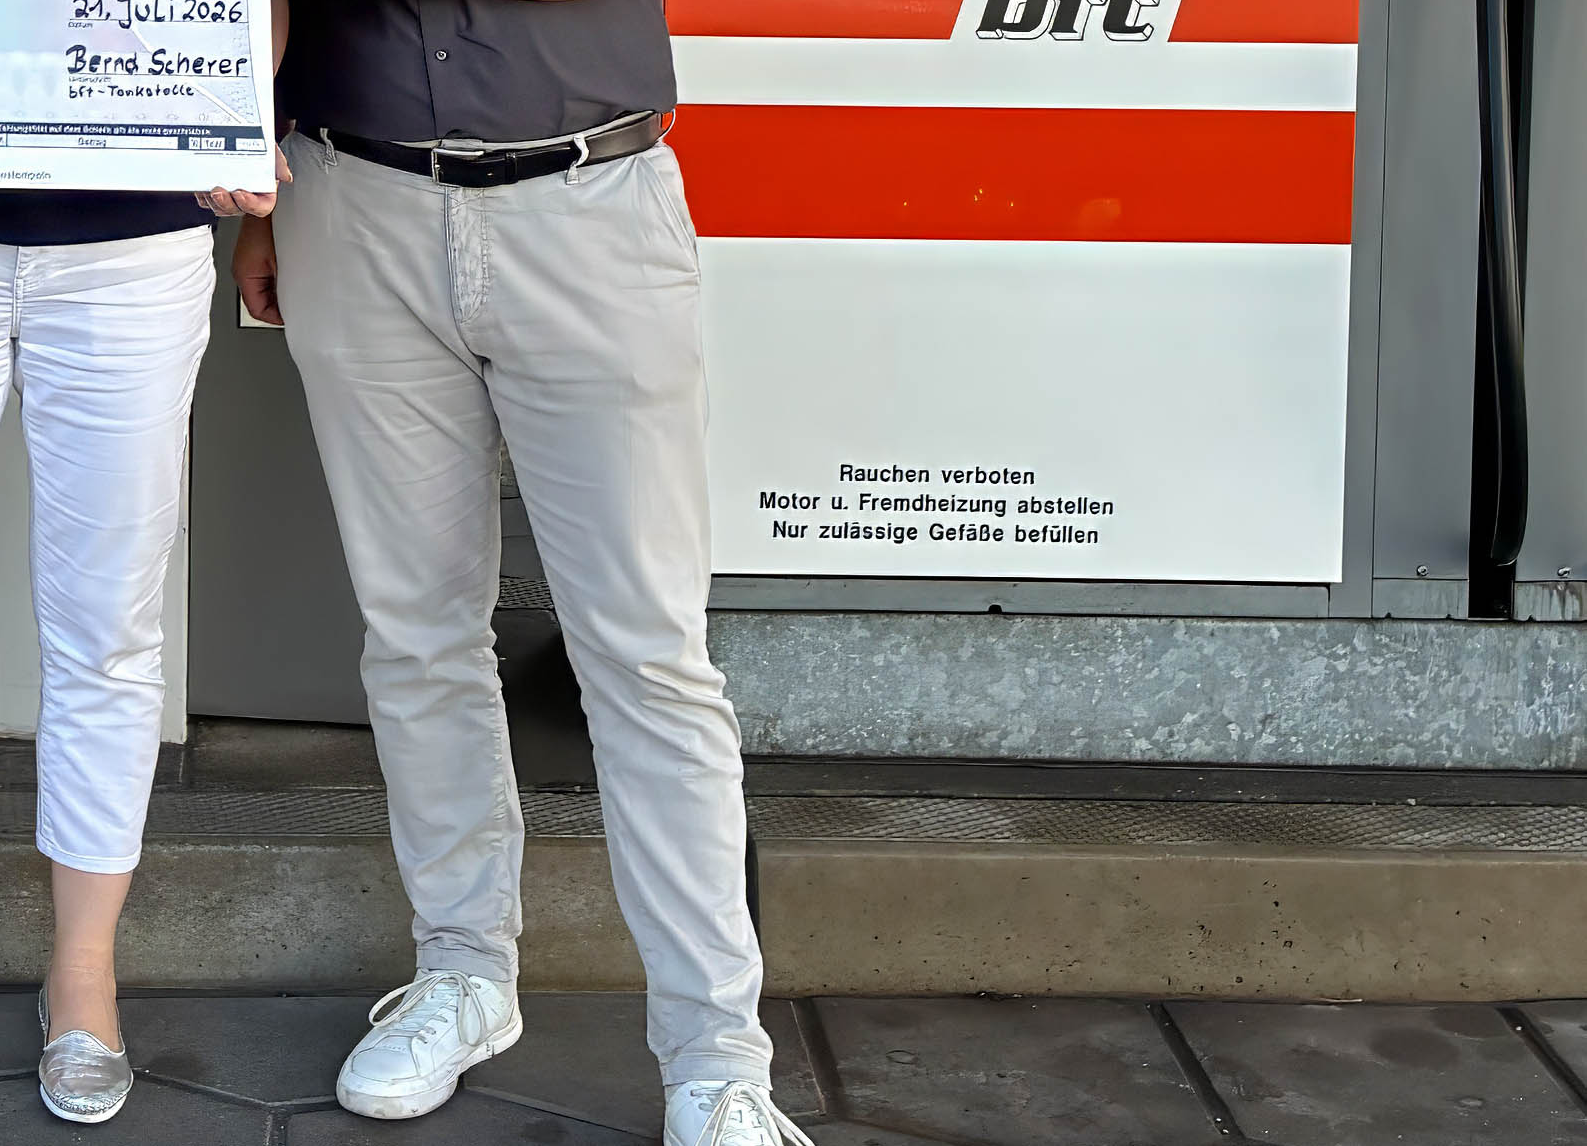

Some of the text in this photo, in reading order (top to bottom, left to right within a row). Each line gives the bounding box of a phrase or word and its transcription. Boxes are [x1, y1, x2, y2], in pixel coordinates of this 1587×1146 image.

[66, 44, 248, 77] Bernd Scherer
[840, 464, 1035, 484] Rauchen verboten
[759, 491, 1114, 517] Motor u. Fremdheizung abstellen
[773, 520, 1099, 544] Nur zulässige Gefäße befüllen
